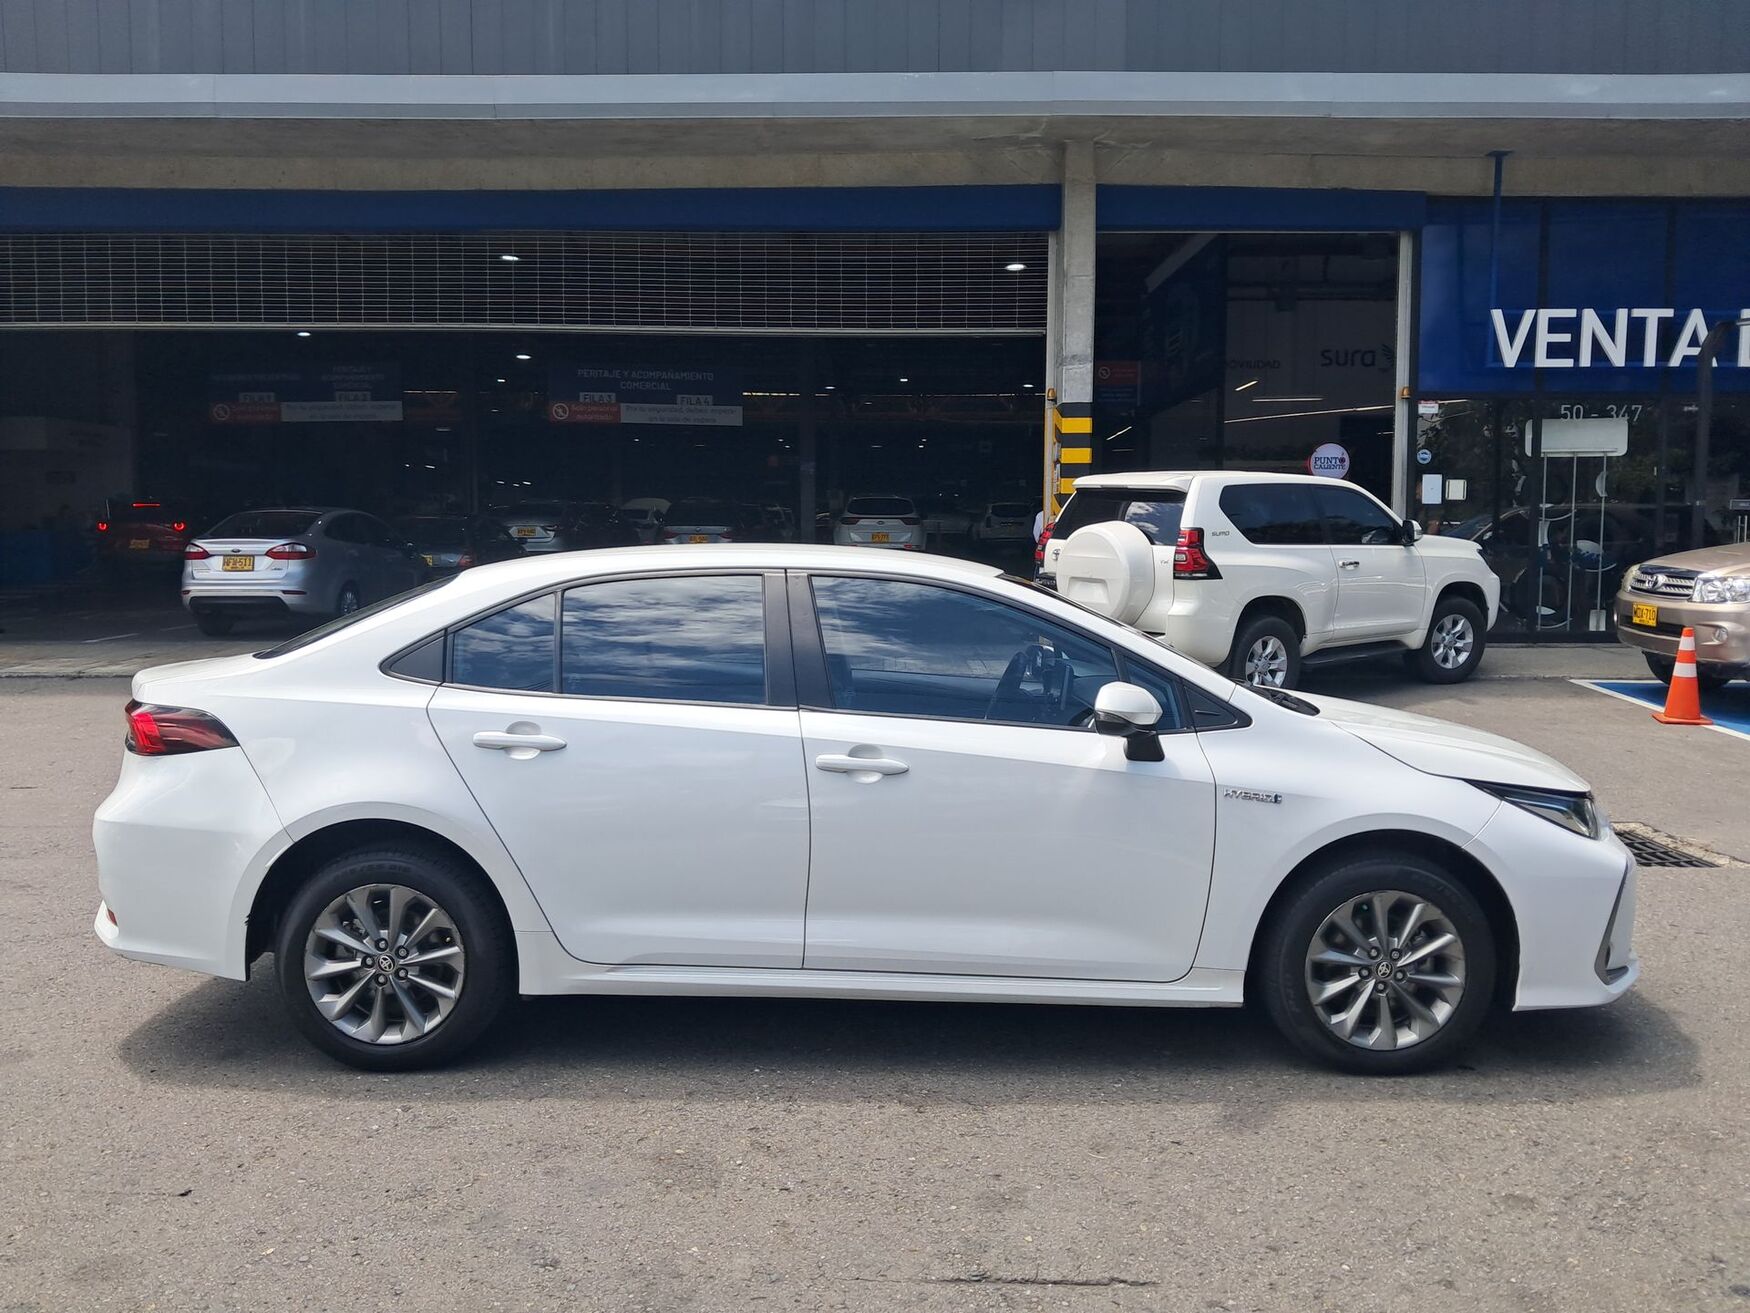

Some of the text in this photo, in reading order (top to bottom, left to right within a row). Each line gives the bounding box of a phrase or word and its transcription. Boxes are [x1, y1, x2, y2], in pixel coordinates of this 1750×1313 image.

[1490, 308, 1718, 368] VENTA
[1320, 349, 1376, 367] sura
[577, 369, 621, 379] PERITAJE
[619, 380, 672, 391] COMERCIAL
[680, 396, 701, 405] FILA
[1560, 404, 1584, 422] 50
[1606, 404, 1642, 422] 347
[1314, 456, 1346, 464] PUNTO
